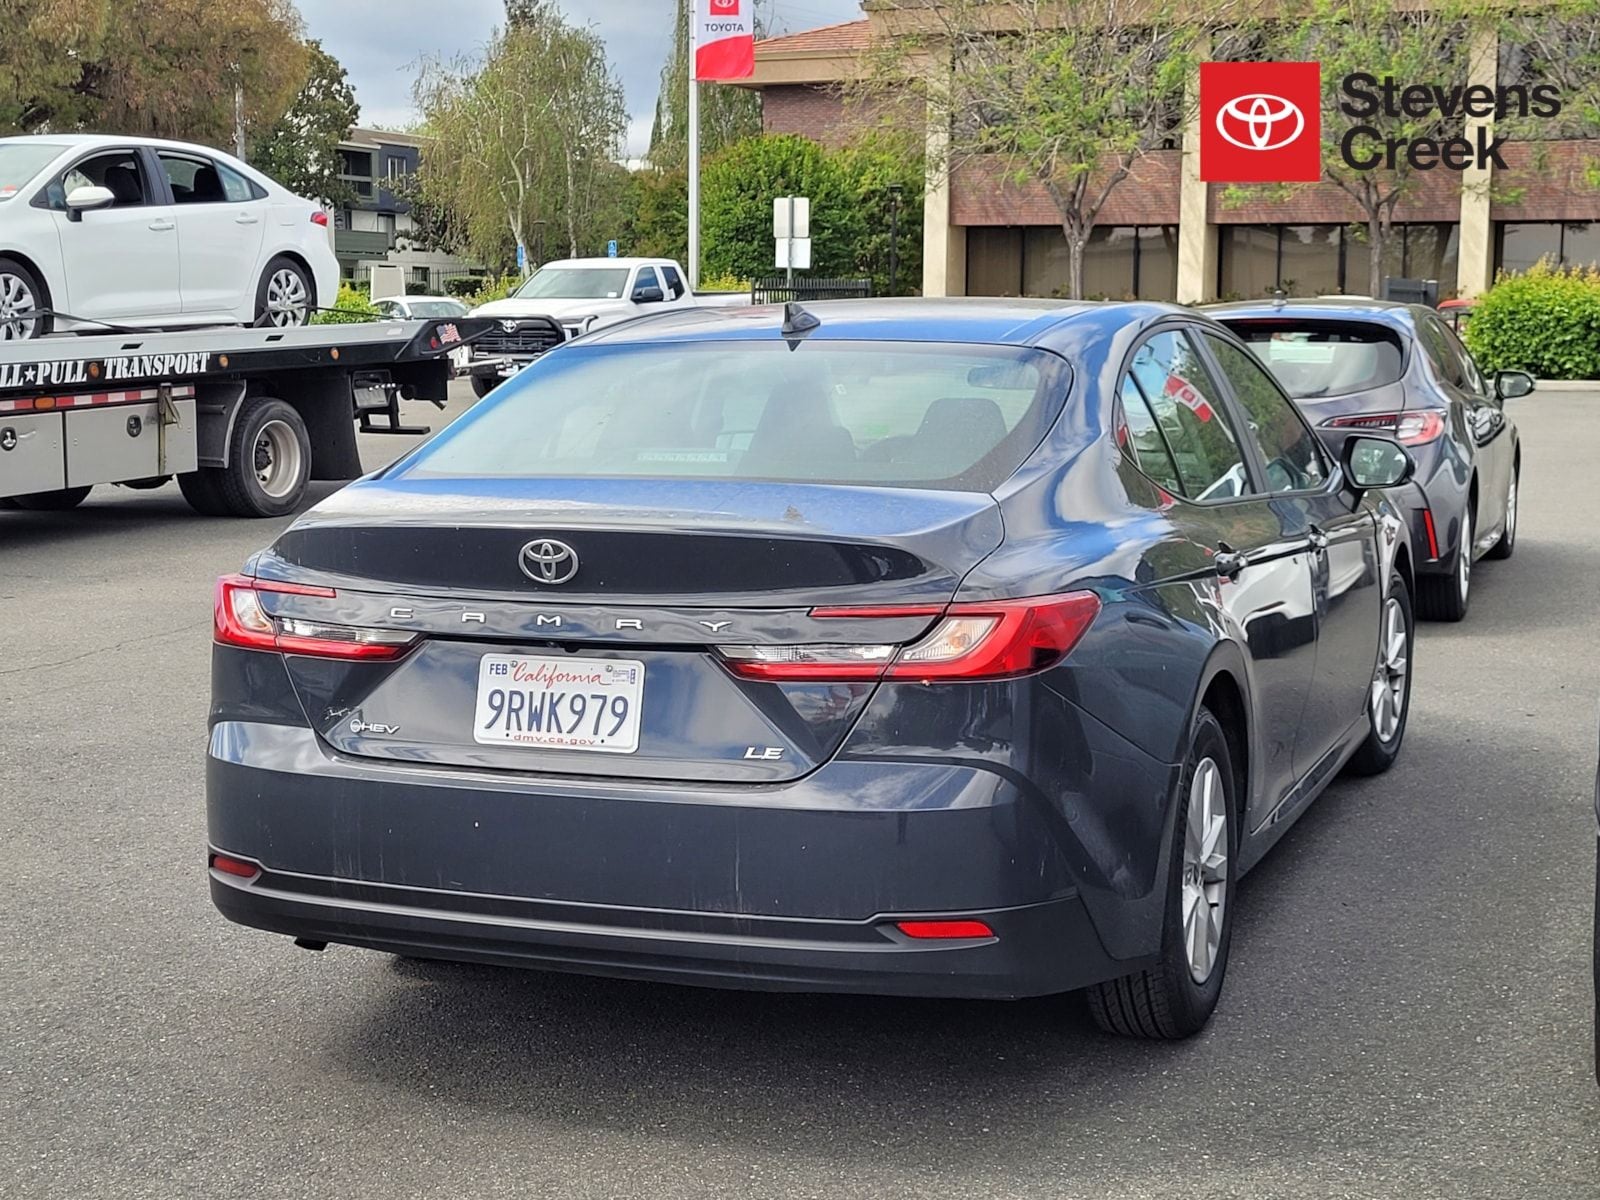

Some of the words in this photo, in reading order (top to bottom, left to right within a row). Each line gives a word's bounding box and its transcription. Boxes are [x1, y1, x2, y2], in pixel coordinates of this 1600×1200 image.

[705, 23, 744, 32] TOYOTA
[104, 351, 211, 380] TRANSPORT
[390, 606, 732, 632] CAMRY
[489, 663, 508, 675] FEB
[513, 661, 612, 689] California
[484, 688, 629, 737] 9RWK979
[361, 721, 400, 734] HEV
[513, 733, 596, 746] dmv.ca.gov
[743, 746, 785, 760] LE
